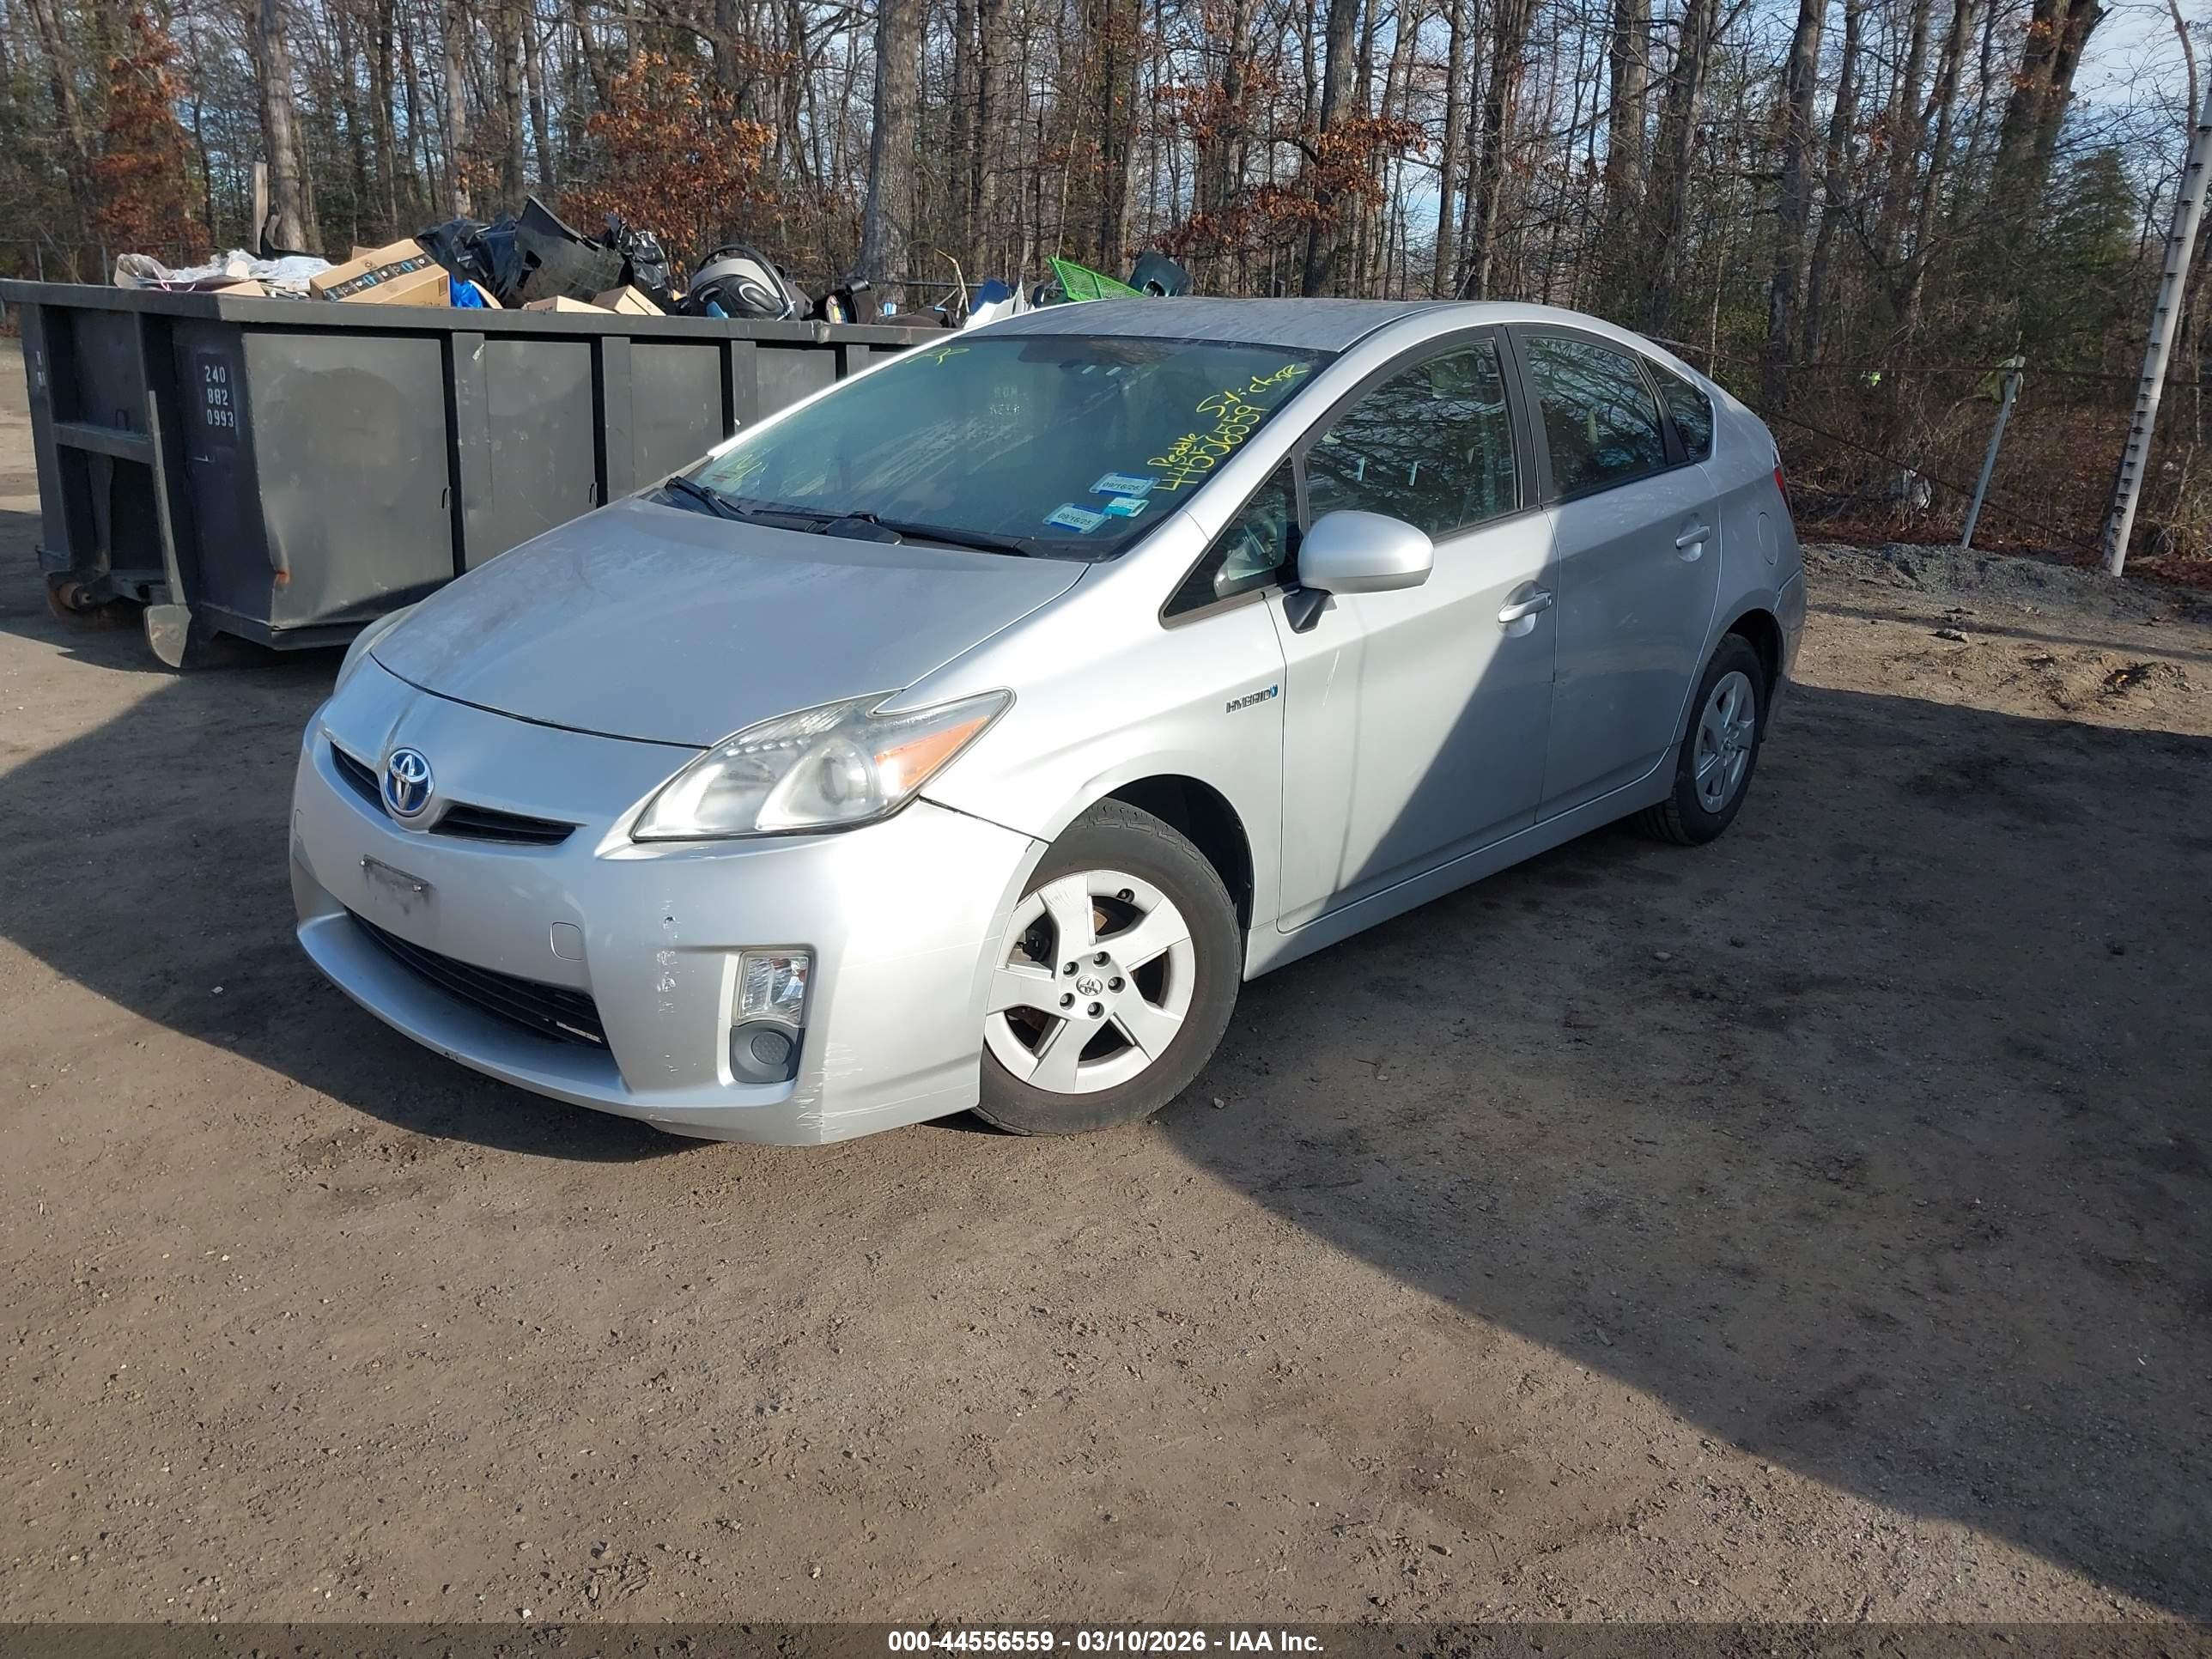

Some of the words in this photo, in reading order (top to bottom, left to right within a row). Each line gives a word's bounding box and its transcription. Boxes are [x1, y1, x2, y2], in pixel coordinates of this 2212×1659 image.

[204, 365, 226, 383] 240
[207, 388, 228, 405] 882
[207, 409, 234, 427] 0993
[1153, 404, 1272, 490] 44556559
[1225, 689, 1272, 714] HYBRID
